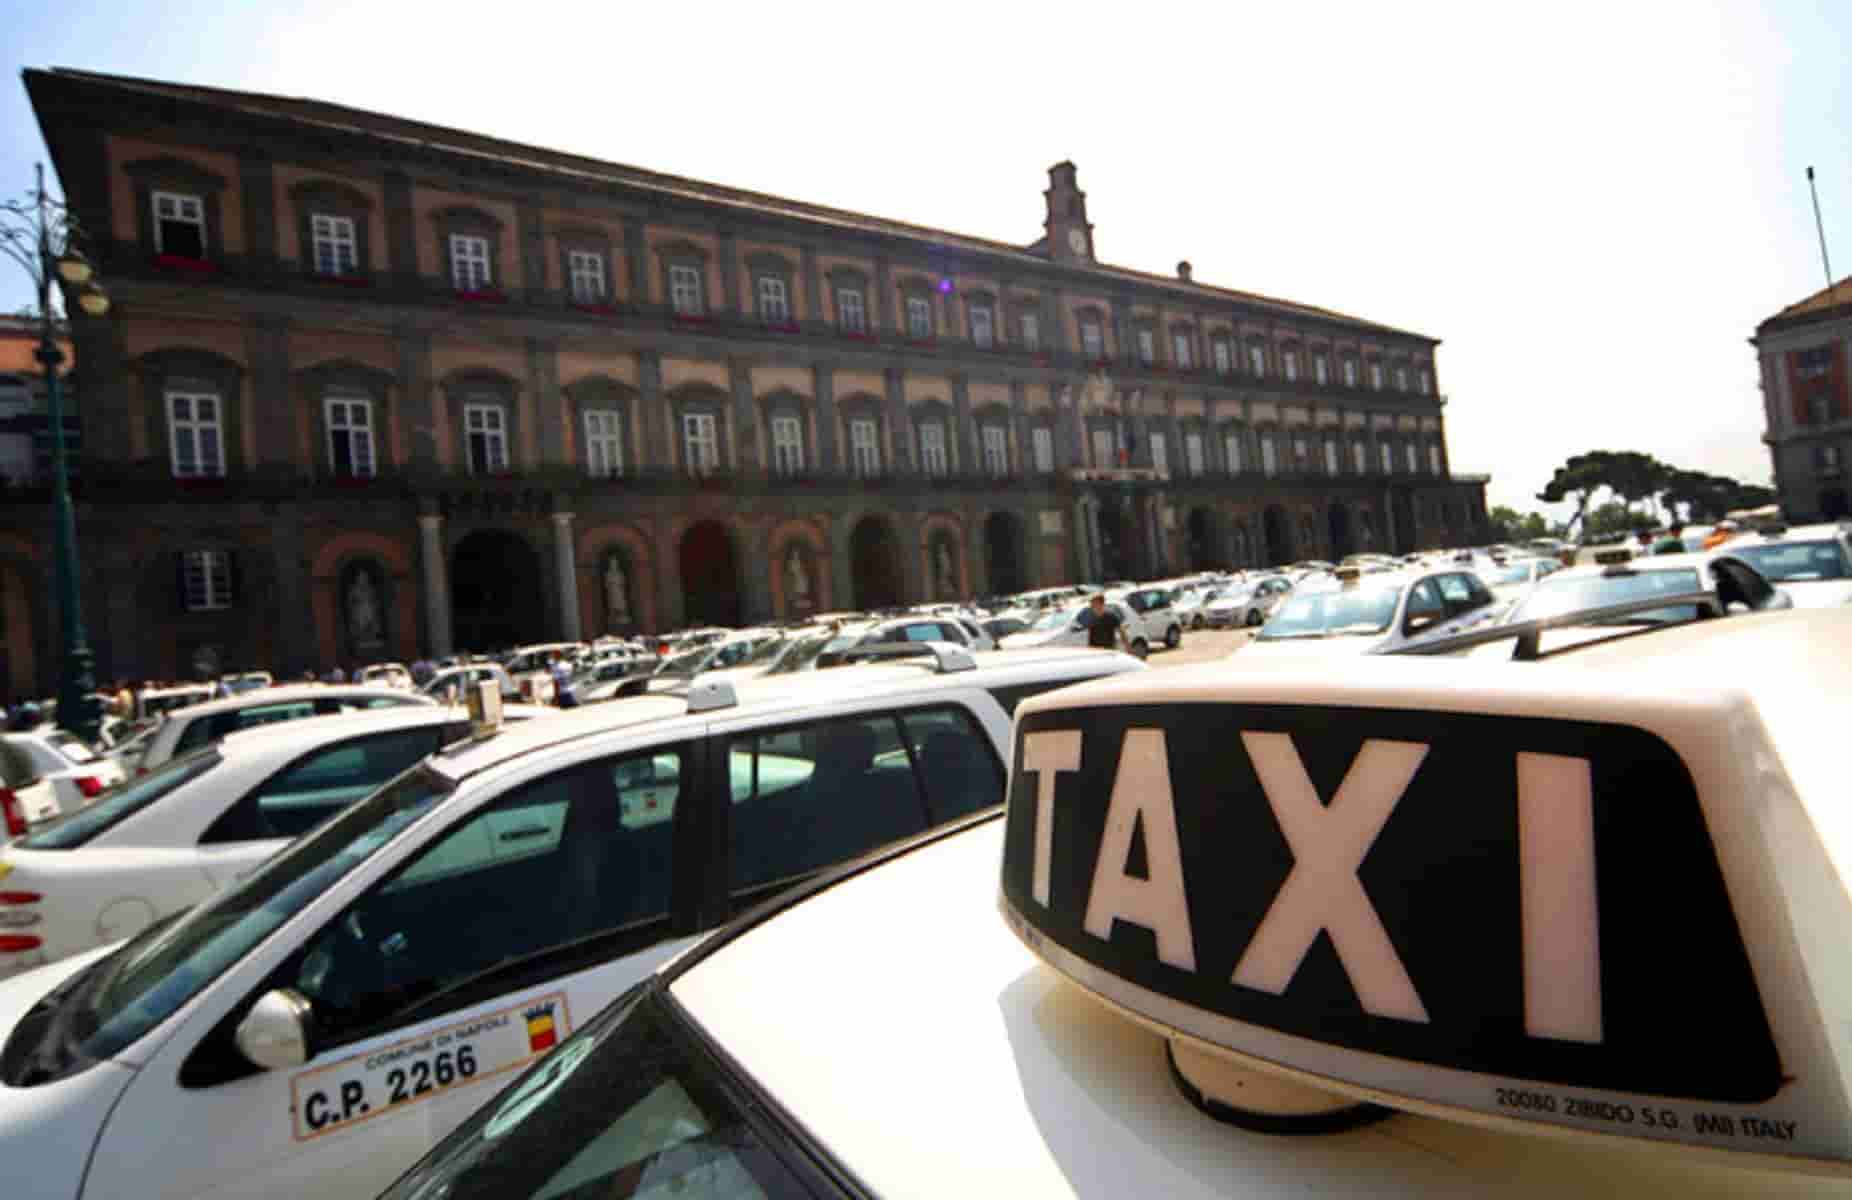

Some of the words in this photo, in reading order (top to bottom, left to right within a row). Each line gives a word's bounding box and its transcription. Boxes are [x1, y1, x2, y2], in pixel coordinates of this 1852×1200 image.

[1022, 728, 1603, 1044] TAXI
[305, 1079, 371, 1129] C.P.
[386, 1045, 477, 1104] 2266
[1742, 1117, 1798, 1142] ITALY
